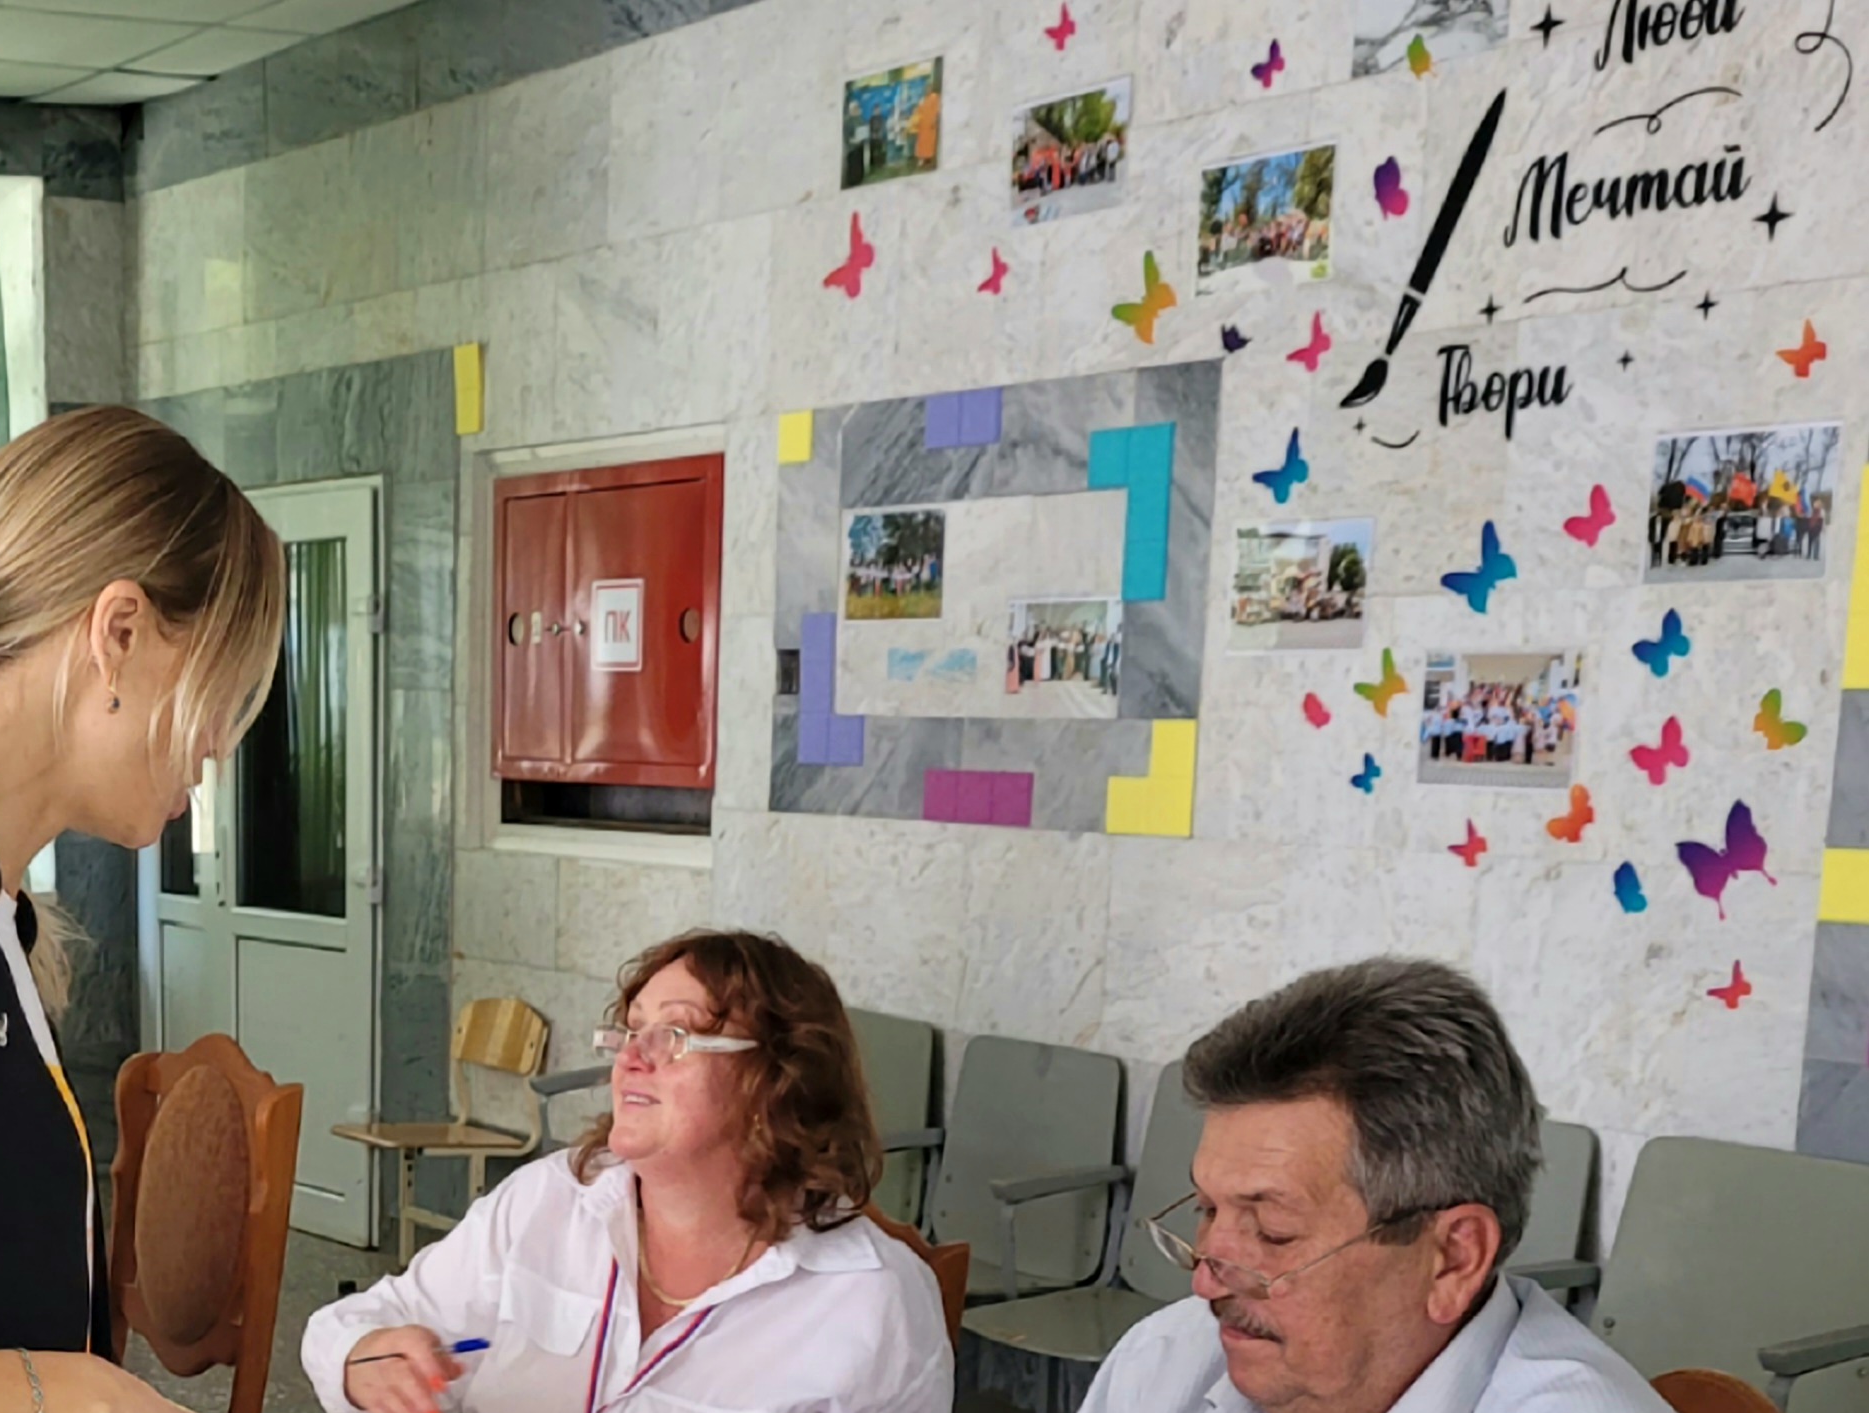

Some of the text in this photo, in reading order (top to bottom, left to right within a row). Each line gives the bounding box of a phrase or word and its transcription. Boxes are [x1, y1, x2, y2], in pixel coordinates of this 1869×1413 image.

[1594, 0, 1746, 71] Люби
[1505, 144, 1752, 248] Мечтай
[1438, 343, 1574, 442] Твори
[604, 610, 631, 643] ПК
